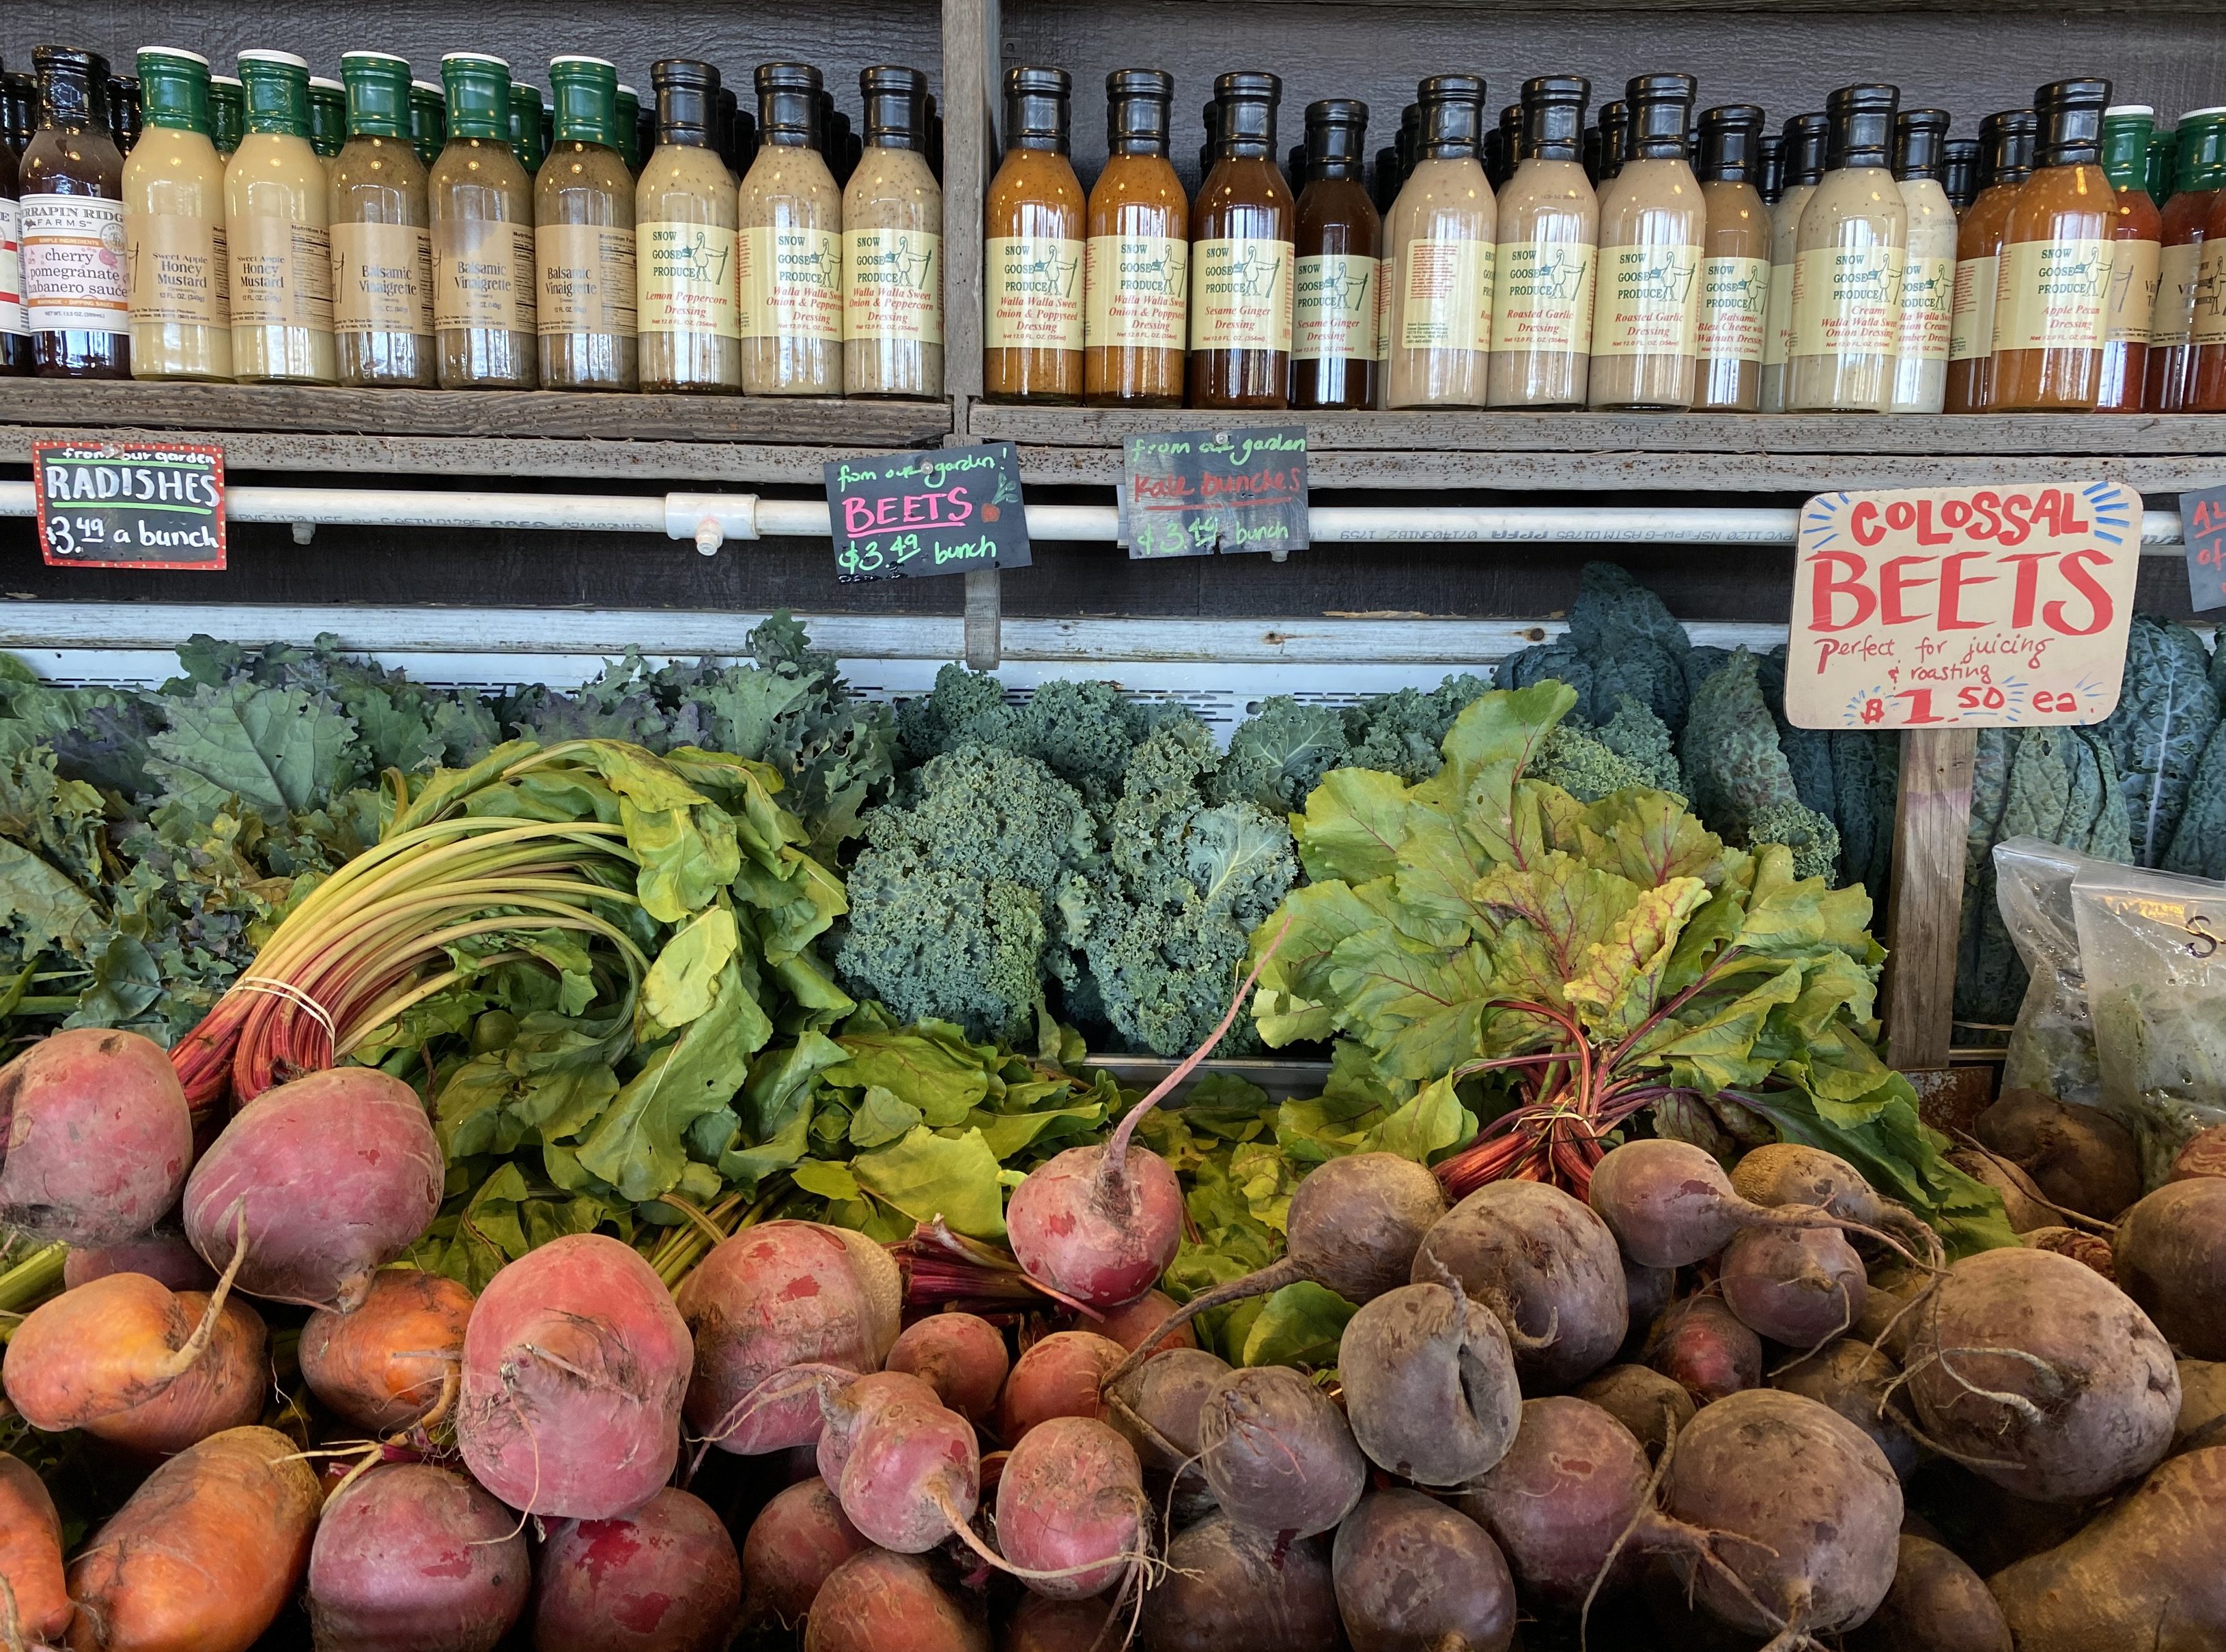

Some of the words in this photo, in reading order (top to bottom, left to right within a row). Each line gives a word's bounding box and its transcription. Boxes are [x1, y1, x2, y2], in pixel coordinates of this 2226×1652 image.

[292, 225, 318, 233] Nutrition
[653, 231, 677, 240] SNOW
[778, 236, 805, 246] SNOW
[858, 238, 880, 246] SNOW
[1006, 246, 1030, 255] SNOW
[1121, 244, 1147, 253] SNOW
[1207, 248, 1229, 257] SNOW
[2042, 248, 2072, 258] SNOW
[45, 248, 94, 265] cherry
[183, 255, 208, 264] Apple
[653, 251, 681, 259] GOOSE
[778, 255, 811, 265] GOOSE
[1512, 251, 1536, 260] SNOW
[1620, 254, 1646, 264] SNOW
[1836, 255, 1865, 265] SNOW
[857, 256, 885, 265] GOOSE
[162, 261, 201, 276] Honey
[244, 264, 278, 276] Honey
[457, 261, 506, 276] Balsamic
[654, 268, 695, 277] PRODUCE
[1005, 265, 1034, 274] GOOSE
[1121, 263, 1152, 272] GOOSE
[1206, 267, 1233, 276] GOOSE
[1299, 264, 1321, 274] SNOW
[1708, 266, 1734, 274] SNOW
[2039, 267, 2074, 277] GOOSE
[30, 268, 119, 280] pomegranate
[779, 272, 821, 283] PRODUCE
[858, 273, 898, 283] PRODUCE
[1510, 270, 1540, 279] GOOSE
[1618, 272, 1650, 282] GOOSE
[1833, 273, 1867, 283] GOOSE
[158, 274, 206, 288] Mustard
[241, 276, 283, 287] Mustard
[455, 276, 511, 292] Vinaigrette
[1121, 281, 1163, 291] PRODUCE
[28, 280, 83, 293] habanero
[89, 285, 128, 297] sauce
[1006, 282, 1047, 291] PRODUCE
[1206, 283, 1245, 294] PRODUCE
[1298, 282, 1325, 291] GOOSE
[1510, 286, 1552, 296] PRODUCE
[2038, 284, 2085, 294] PRODUCE
[774, 287, 800, 296] Walla
[804, 288, 828, 298] Walla
[854, 288, 874, 296] Walla
[878, 288, 904, 297] Walla
[907, 289, 931, 300] Sweet
[1618, 289, 1662, 299] PRODUCE
[1833, 290, 1878, 300] PRODUCE
[646, 291, 672, 300] Lemon
[676, 291, 727, 305] Peppercorn
[767, 297, 795, 306] Onion
[799, 298, 806, 307] &
[1001, 297, 1024, 306] Walla
[1028, 298, 1053, 307] Walla
[1056, 298, 1076, 309] Sweet
[1114, 295, 1140, 304] Walla
[1144, 296, 1168, 306] Walla
[1298, 298, 1338, 307] PRODUCE
[849, 298, 870, 307] Onion
[885, 300, 933, 311] Peppercorn
[1706, 299, 1747, 308] PRODUCE
[665, 306, 706, 318] Dressing
[1110, 307, 1136, 316] Onion
[1141, 308, 1148, 316] &
[1205, 307, 1236, 315] Sesame
[1240, 306, 1271, 317] Ginger
[1508, 310, 1542, 319] Roasted
[1546, 310, 1573, 319] Garlic
[1851, 307, 1887, 315] Creamy
[2042, 306, 2072, 315] Apple
[2076, 305, 2100, 314] Pecan
[793, 311, 830, 324] Dressing
[868, 313, 907, 324] Dressing
[997, 309, 1021, 318] Onion
[1025, 309, 1032, 317] &
[1037, 310, 1077, 322] Poppyseed
[1615, 313, 1653, 322] Roasted
[1656, 313, 1683, 322] Garlic
[1720, 313, 1757, 323] Balsamic
[1017, 322, 1057, 333] Dressing
[1131, 319, 1170, 332] Dressing
[1215, 320, 1255, 330] Dressing
[1297, 320, 1327, 328] Sesame
[1331, 318, 1359, 328] Ginger
[1698, 323, 1718, 331] Bleu
[1722, 323, 1751, 331] Cheese
[1822, 319, 1848, 327] Walla
[1853, 319, 1878, 327] Walla
[2051, 319, 2092, 330] Dressing
[1518, 324, 1560, 334] Dressing
[1627, 326, 1670, 337] Dressing
[1827, 328, 1856, 337] Onion
[1861, 328, 1893, 338] Dressing
[1307, 332, 1344, 342] Dressing
[1131, 439, 1189, 461] from
[1229, 433, 1306, 466] garden
[120, 452, 152, 461] our
[154, 452, 216, 464] garden
[838, 465, 876, 492] from
[1201, 468, 1300, 496] bunches
[45, 466, 220, 507] RADISHES
[842, 487, 972, 532] BEETS
[1851, 489, 2089, 546] COLOSSAL
[113, 529, 130, 543] a
[138, 519, 219, 548] bunch
[1236, 521, 1288, 545] bunch
[1340, 531, 1376, 539] 1759
[1492, 530, 1547, 539] PPFA
[1557, 531, 1599, 539] D1785
[1604, 531, 1643, 539] ASTM
[1764, 532, 1794, 540] PVC
[839, 534, 920, 574] $3.49
[935, 535, 996, 565] bunch
[1805, 549, 2113, 636] BEETS
[1916, 638, 1948, 664] for
[1964, 633, 2056, 668] juicing
[1912, 663, 1991, 684] roasting
